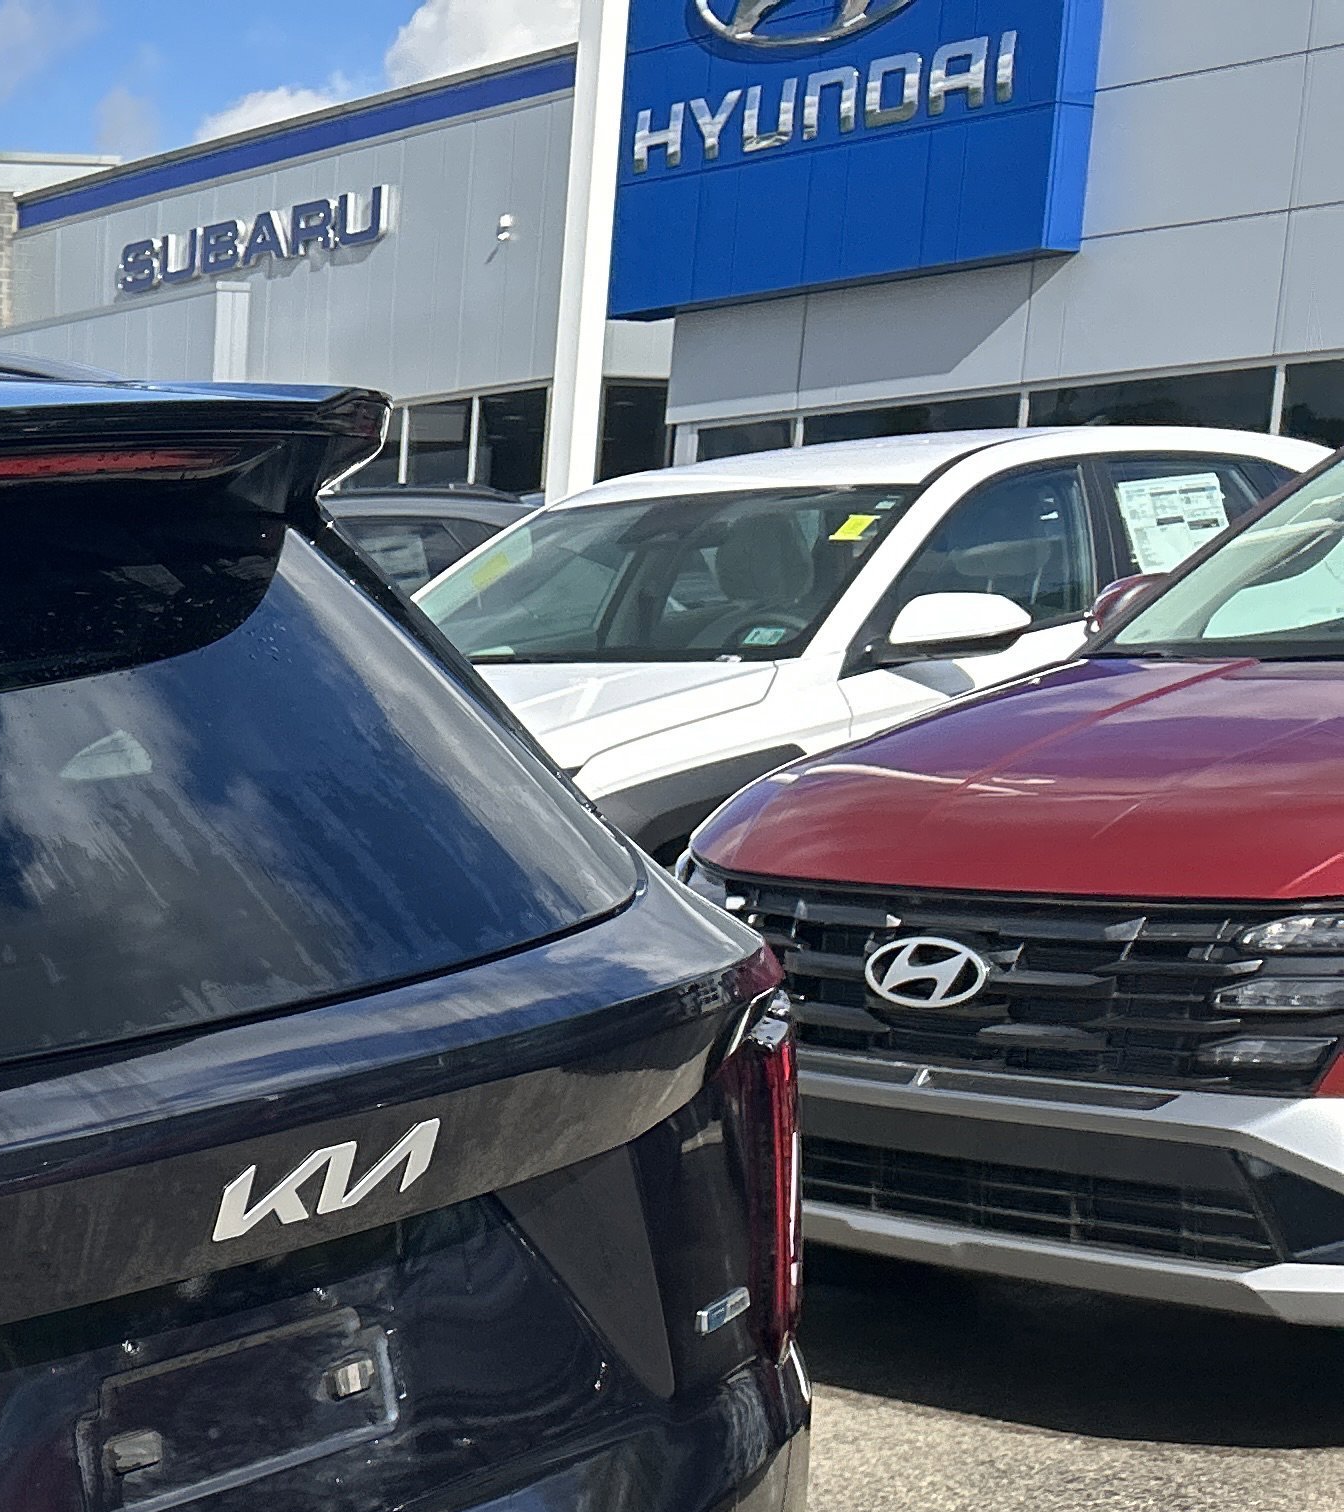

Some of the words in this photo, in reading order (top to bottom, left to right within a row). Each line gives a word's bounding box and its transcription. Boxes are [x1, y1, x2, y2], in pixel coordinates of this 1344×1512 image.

[632, 30, 1019, 174] HYUNDAI
[116, 183, 392, 293] SUBARU
[213, 1118, 440, 1242] KIA
